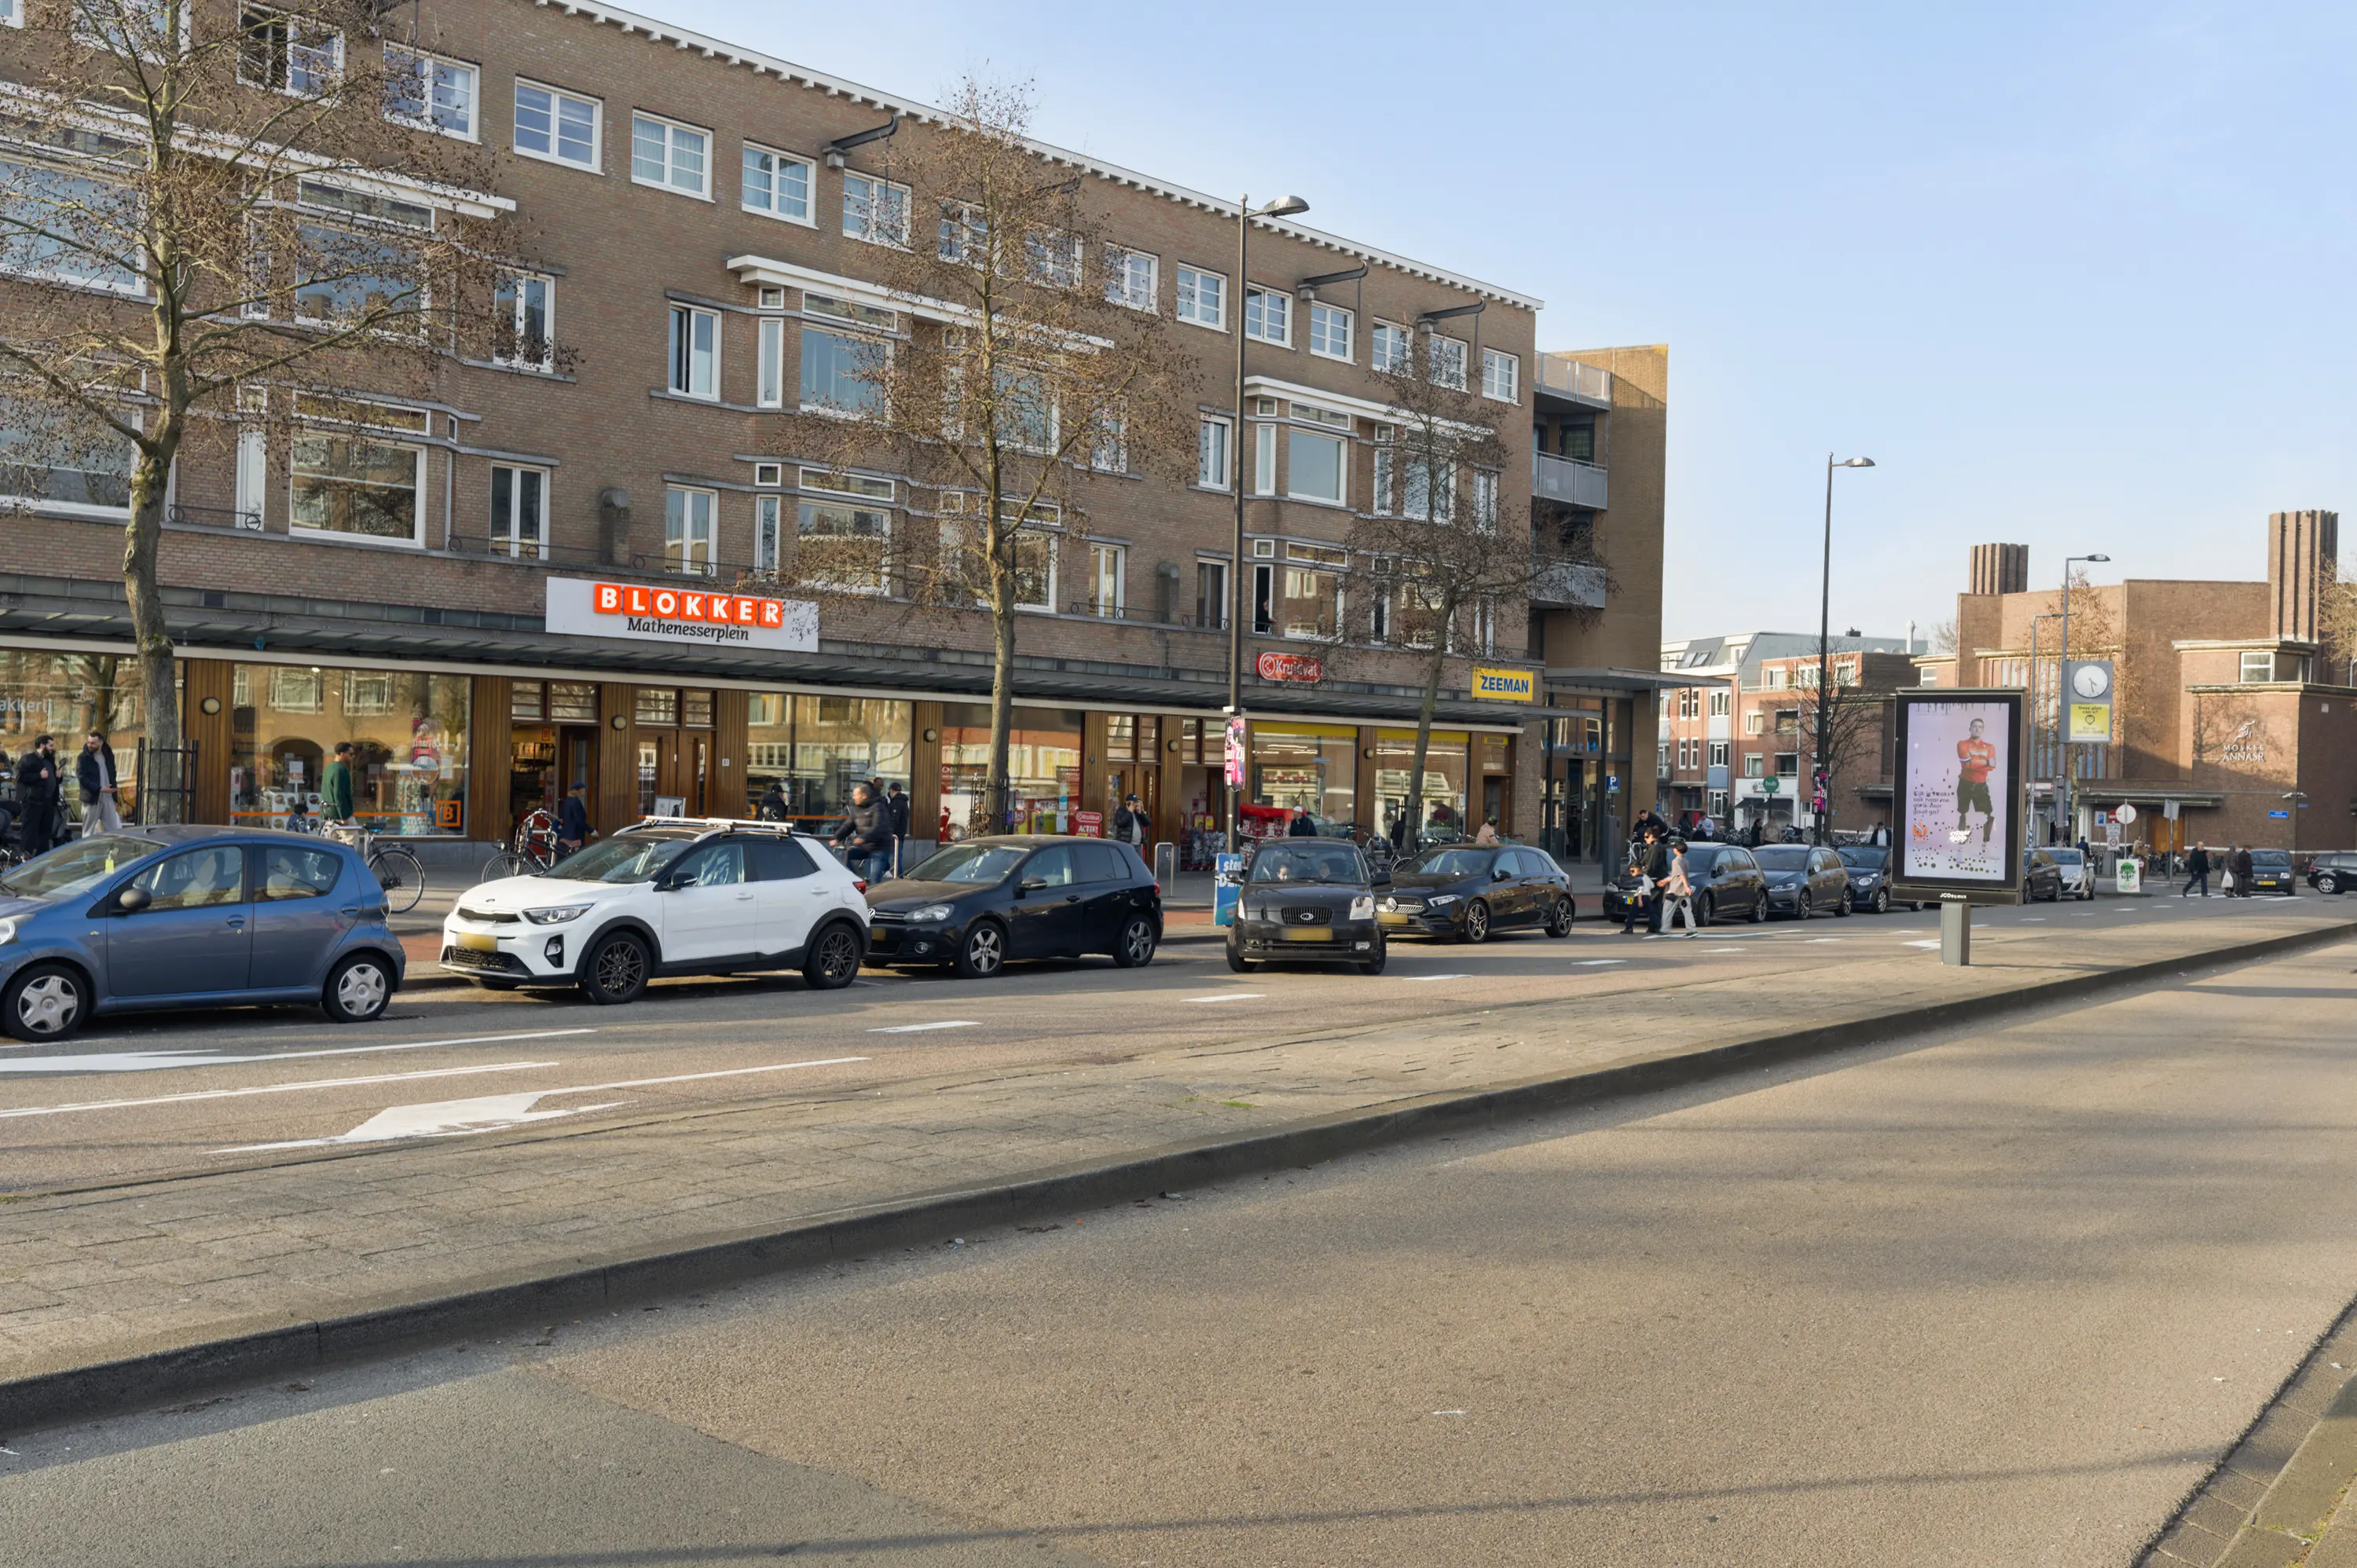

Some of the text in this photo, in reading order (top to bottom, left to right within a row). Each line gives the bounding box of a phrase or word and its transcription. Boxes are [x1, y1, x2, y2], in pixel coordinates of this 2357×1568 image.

[600, 587, 779, 623] BLOKKER
[627, 617, 750, 643] Mathenesserplein
[1275, 659, 1318, 676] Kruidvat
[1480, 676, 1529, 694] ZEEMAN
[2222, 753, 2264, 761] ANNASR
